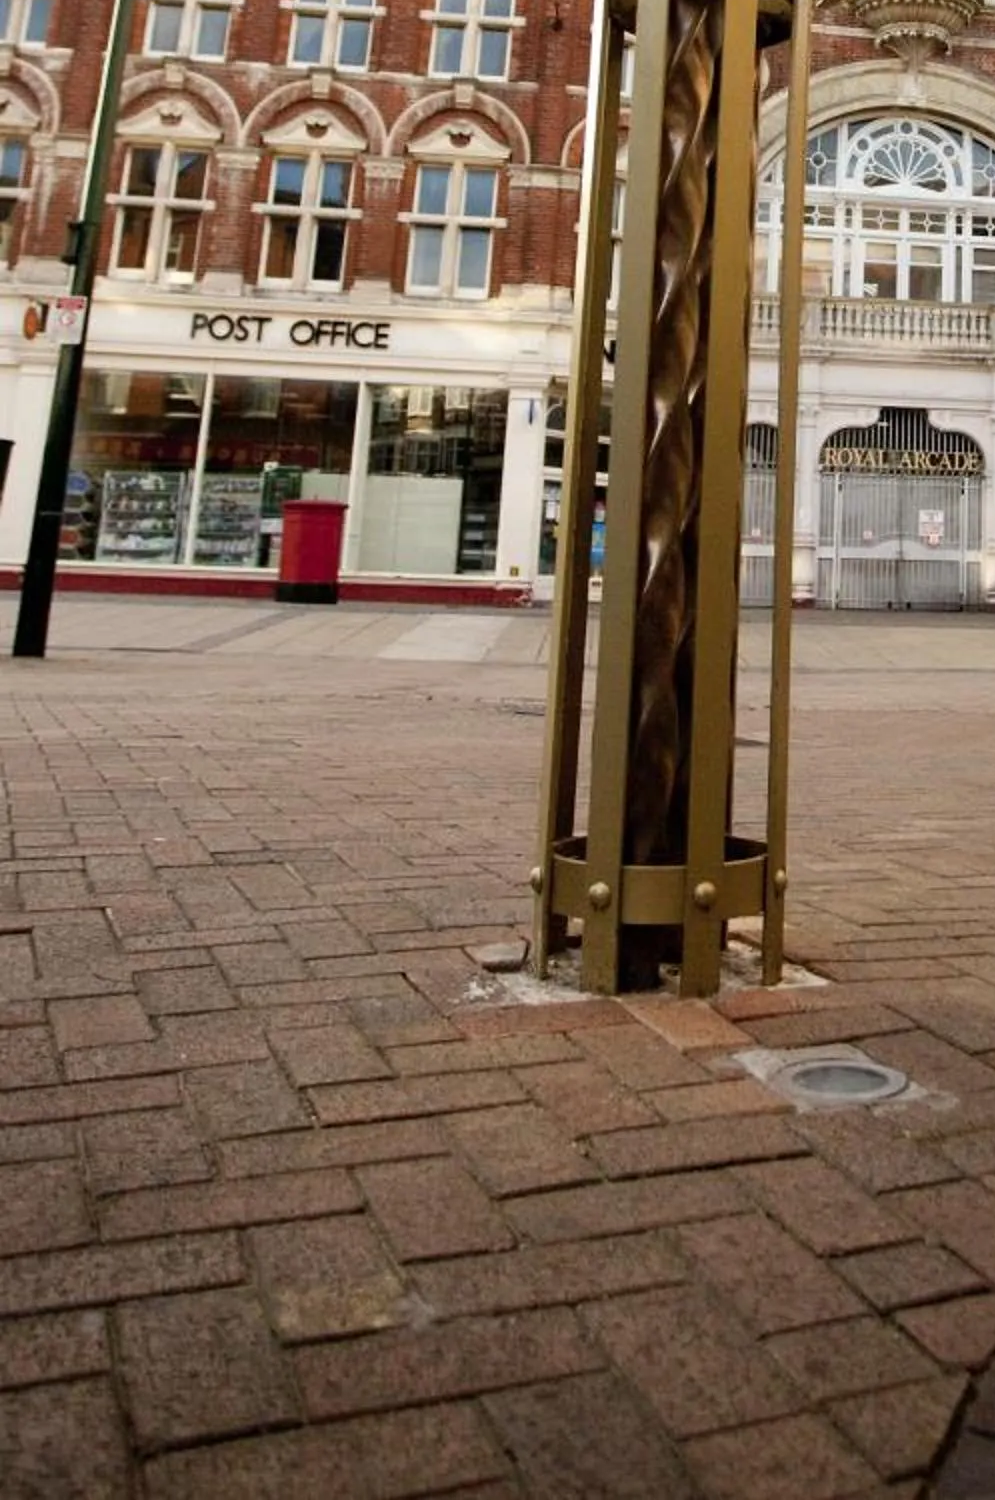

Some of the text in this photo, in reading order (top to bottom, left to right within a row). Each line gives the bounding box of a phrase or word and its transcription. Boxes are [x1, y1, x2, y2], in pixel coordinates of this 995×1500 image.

[190, 313, 390, 349] POST OFFICE
[825, 448, 980, 470] ROYAL ARCADE
